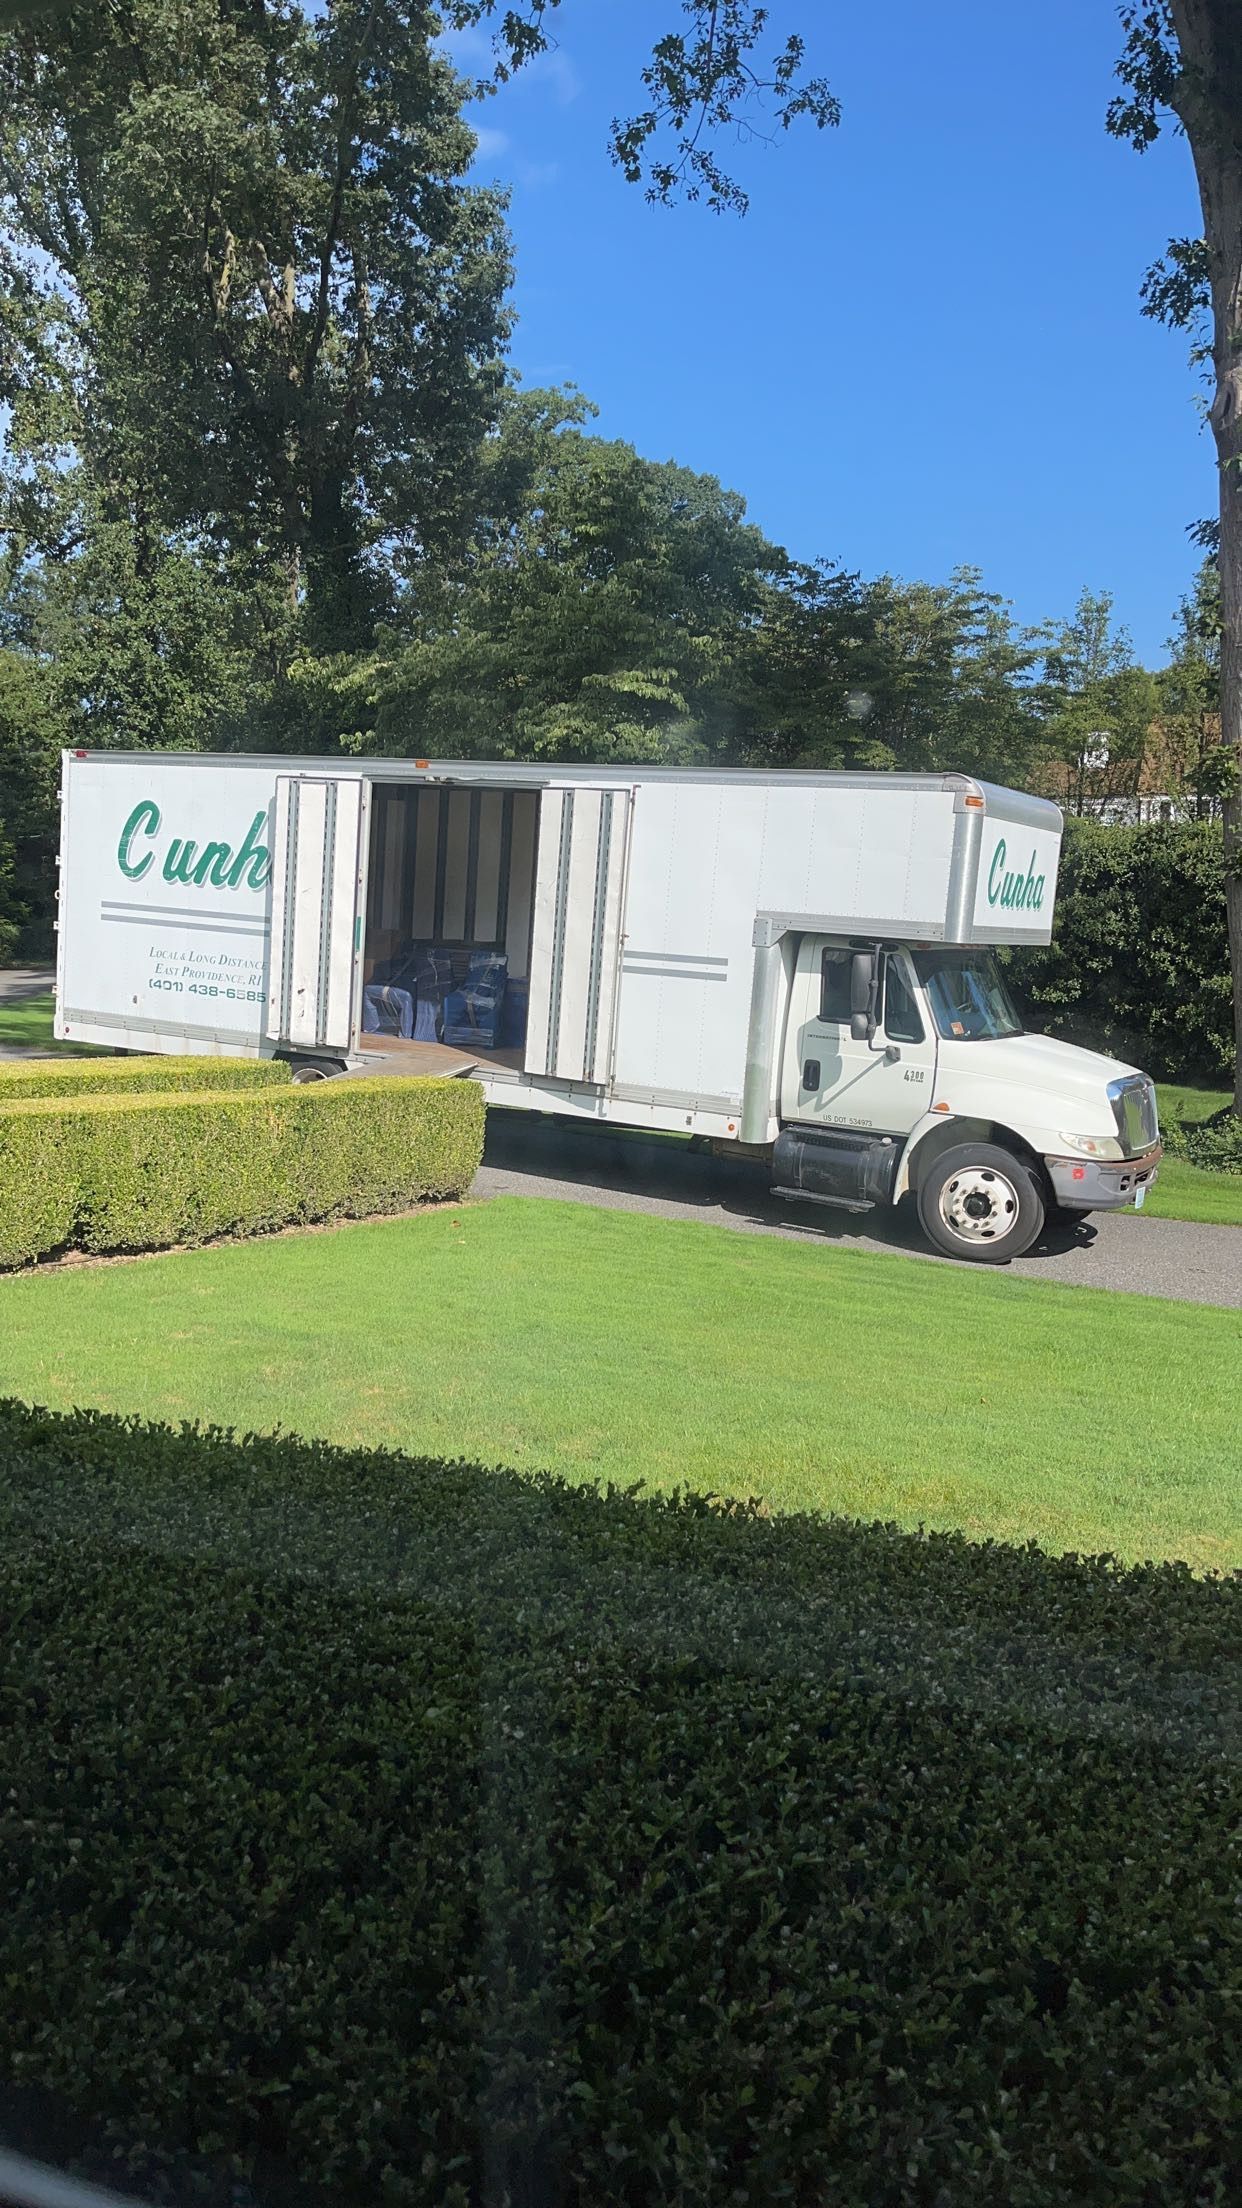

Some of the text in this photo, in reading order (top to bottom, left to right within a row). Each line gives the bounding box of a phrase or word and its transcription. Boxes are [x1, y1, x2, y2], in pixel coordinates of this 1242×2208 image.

[118, 799, 272, 890] Cunh
[987, 838, 1046, 911] Cunha
[149, 946, 269, 971] LOCAL & LONG DISTANCE
[154, 962, 262, 987] EAST PROVIDENCE, RI
[148, 978, 267, 1003] (401) 438-6585
[823, 1114, 832, 1122] US
[834, 1115, 847, 1124] DOT
